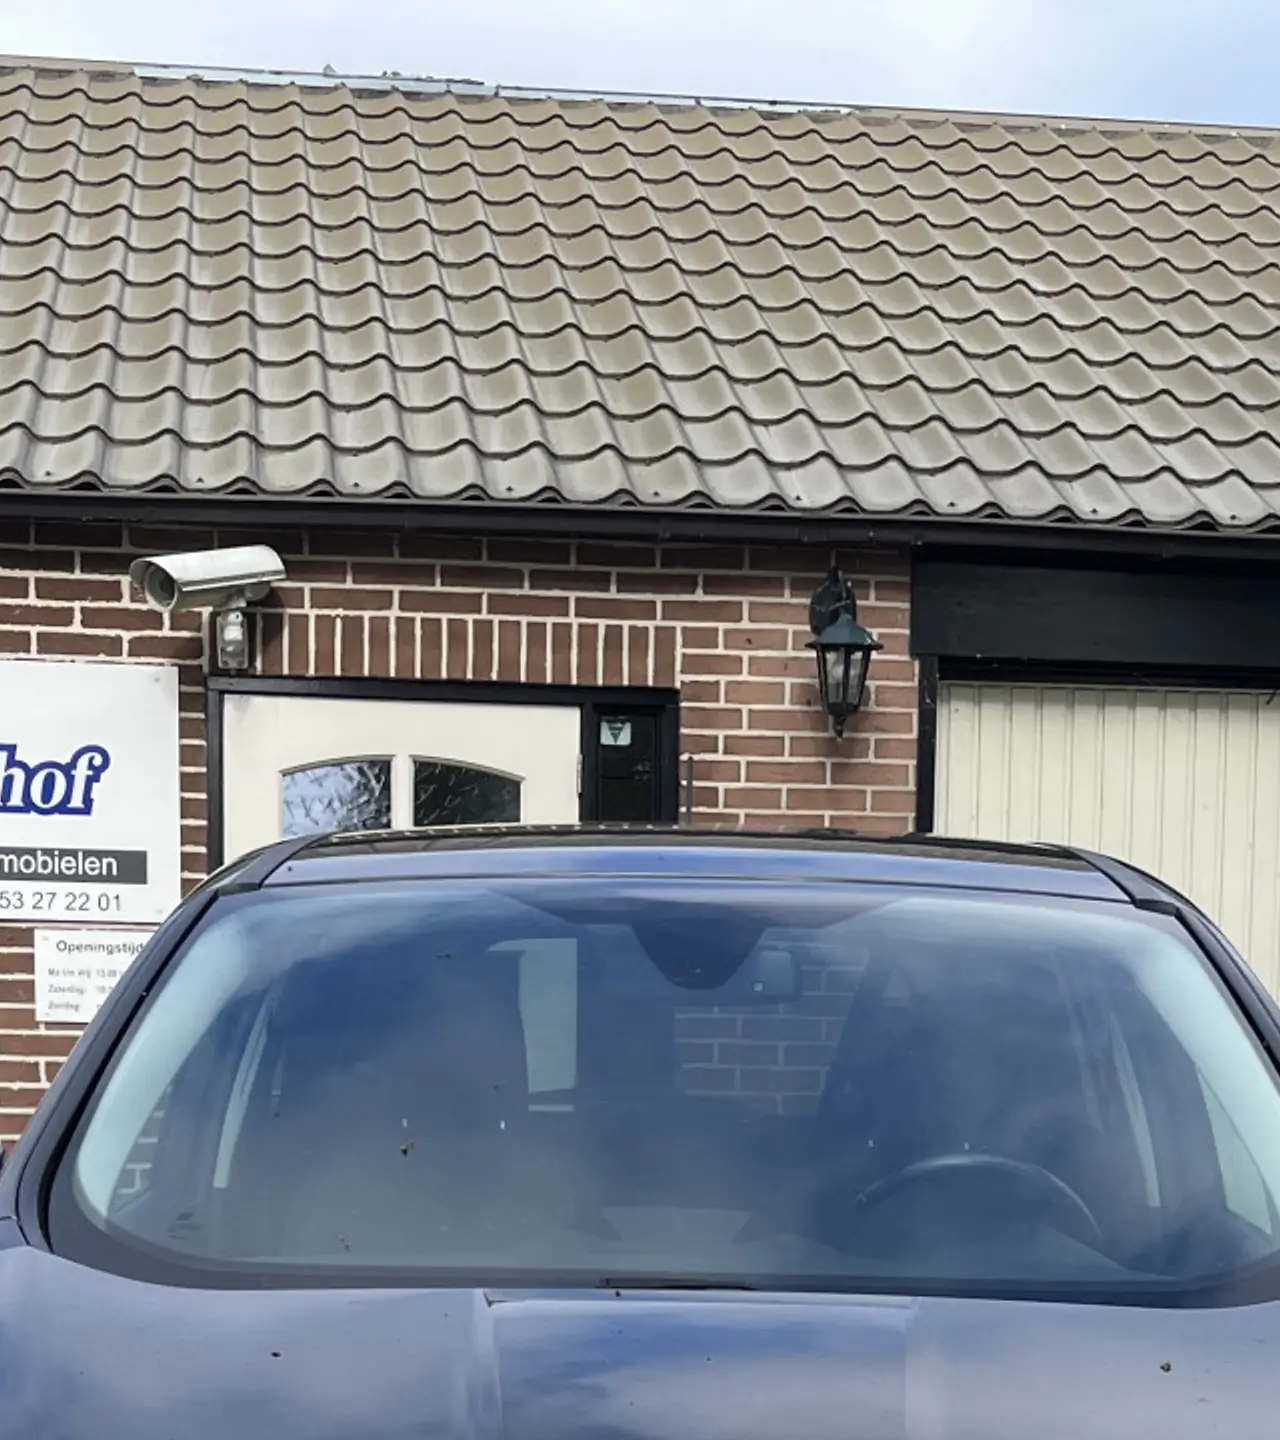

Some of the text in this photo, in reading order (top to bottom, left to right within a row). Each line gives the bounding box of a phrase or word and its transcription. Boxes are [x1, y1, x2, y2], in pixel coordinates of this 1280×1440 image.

[32, 892, 56, 910] 27
[65, 892, 90, 911] 22
[97, 893, 121, 911] 01
